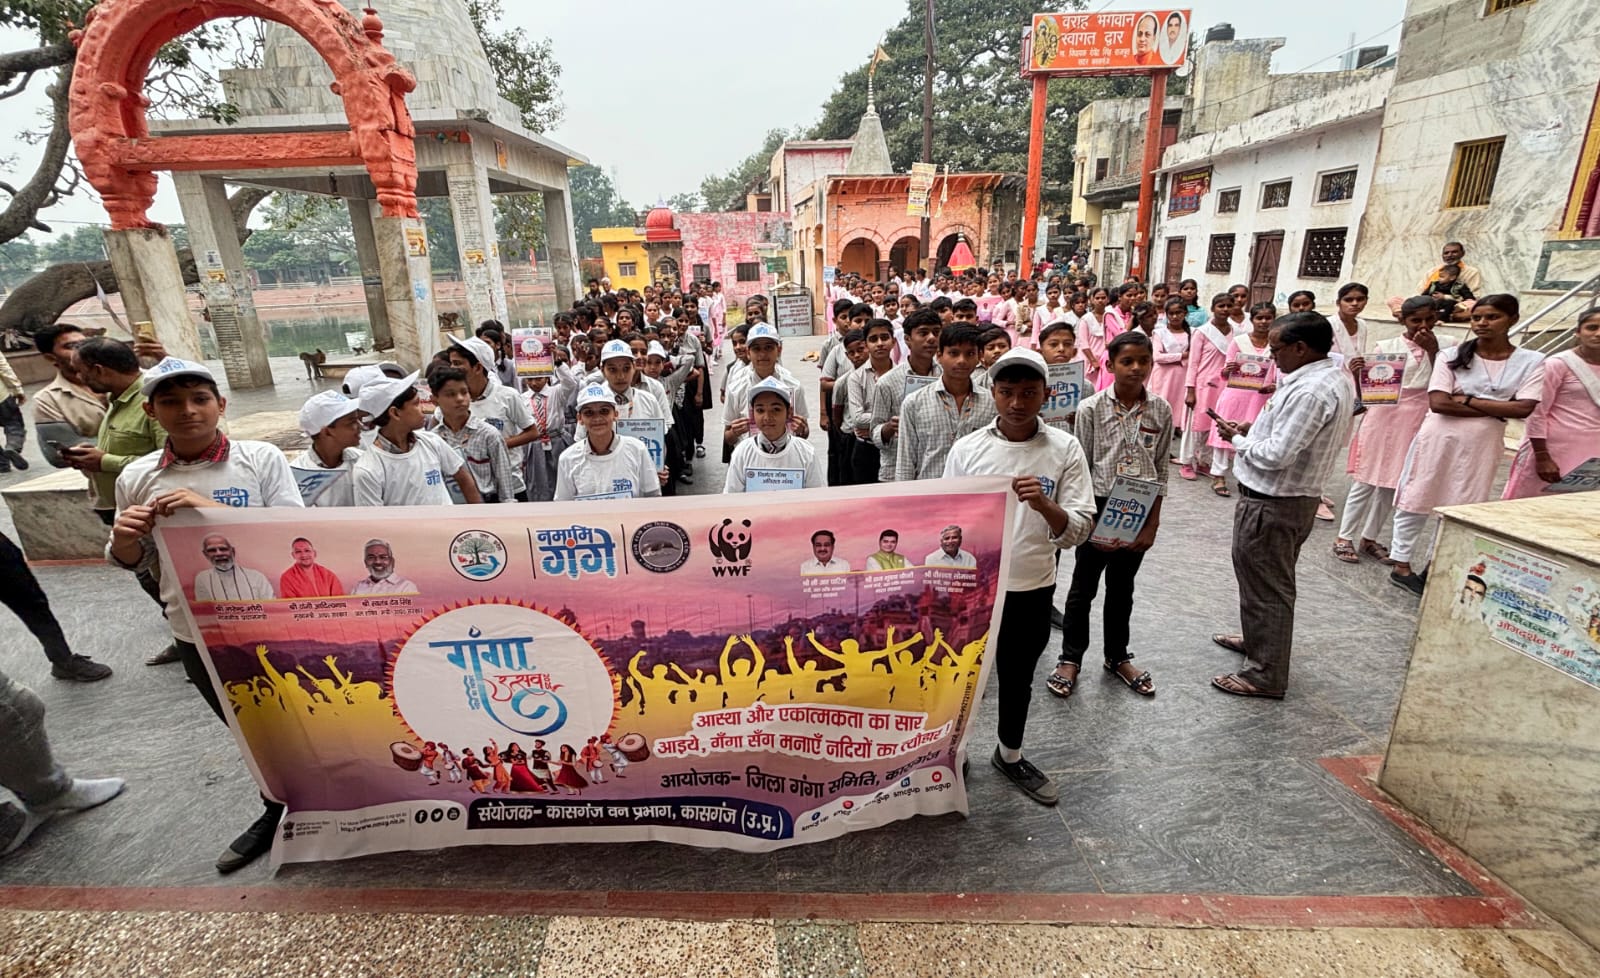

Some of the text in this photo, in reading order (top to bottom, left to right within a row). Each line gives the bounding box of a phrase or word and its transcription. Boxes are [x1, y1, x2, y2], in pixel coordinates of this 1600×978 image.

[1062, 13, 1136, 30] वराह भगवान
[1060, 30, 1124, 46] स्वागत द्वार
[1109, 497, 1140, 512] नमामि
[1103, 504, 1146, 532] गंगे
[536, 525, 593, 545] नमामि
[539, 528, 616, 578] गंगे
[712, 565, 752, 577] WWF
[483, 673, 546, 701] उत्सव
[696, 705, 924, 732] आस्था और एकात्मकता का सार
[710, 732, 743, 749] गँगा
[747, 729, 776, 749] सँग
[779, 733, 823, 756] मनाएँ
[826, 736, 873, 759] नदियों
[877, 743, 899, 757] का
[660, 768, 741, 789] आयोजक-
[746, 765, 786, 794] जिला
[789, 774, 824, 799] गंगा
[828, 771, 880, 796] समिति,
[893, 787, 921, 800] smcgup
[925, 781, 952, 795] smcgup
[478, 801, 784, 839] संयोजक- कासगंज वन प्रभाग, कासगंज (उ.प्र.)
